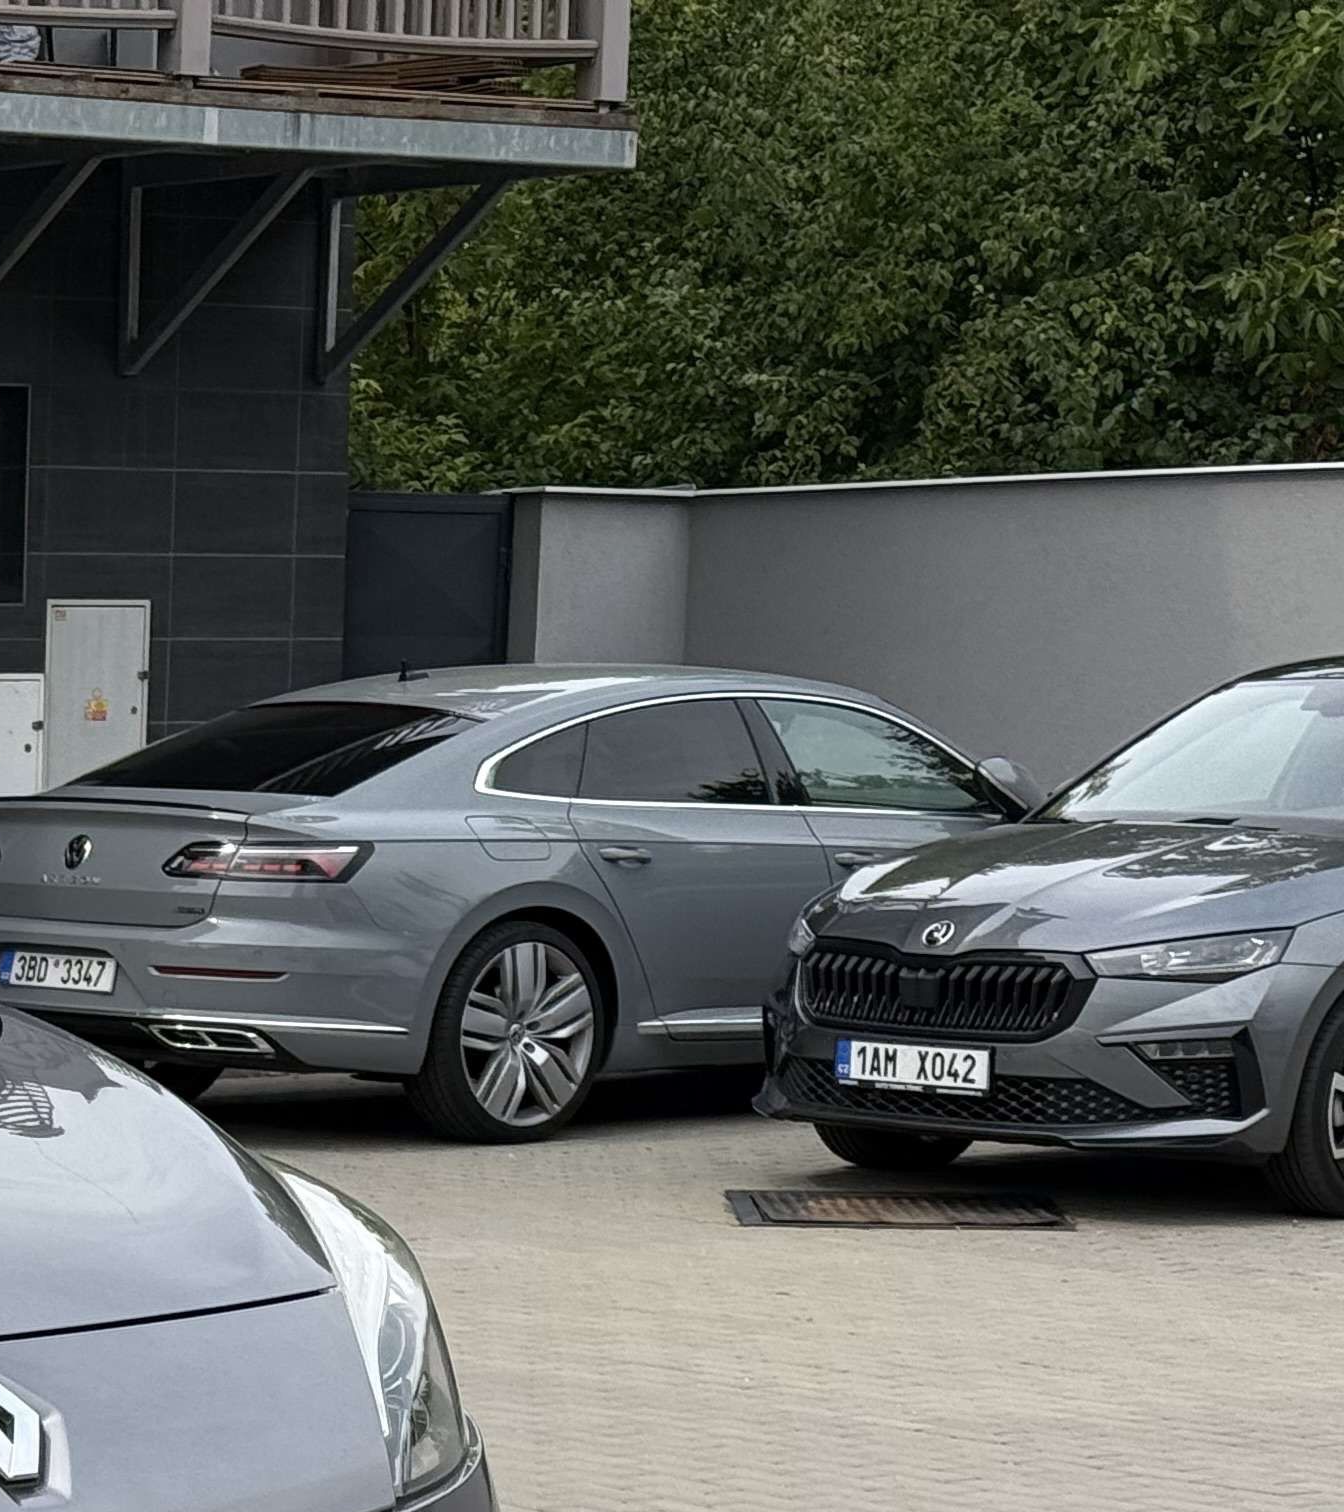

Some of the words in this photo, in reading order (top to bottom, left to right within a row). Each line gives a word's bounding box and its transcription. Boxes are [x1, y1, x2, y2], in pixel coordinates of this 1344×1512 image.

[14, 955, 49, 983] 3BD
[60, 958, 107, 987] 3347
[857, 1045, 898, 1078] 1AM
[916, 1050, 977, 1085] X042
